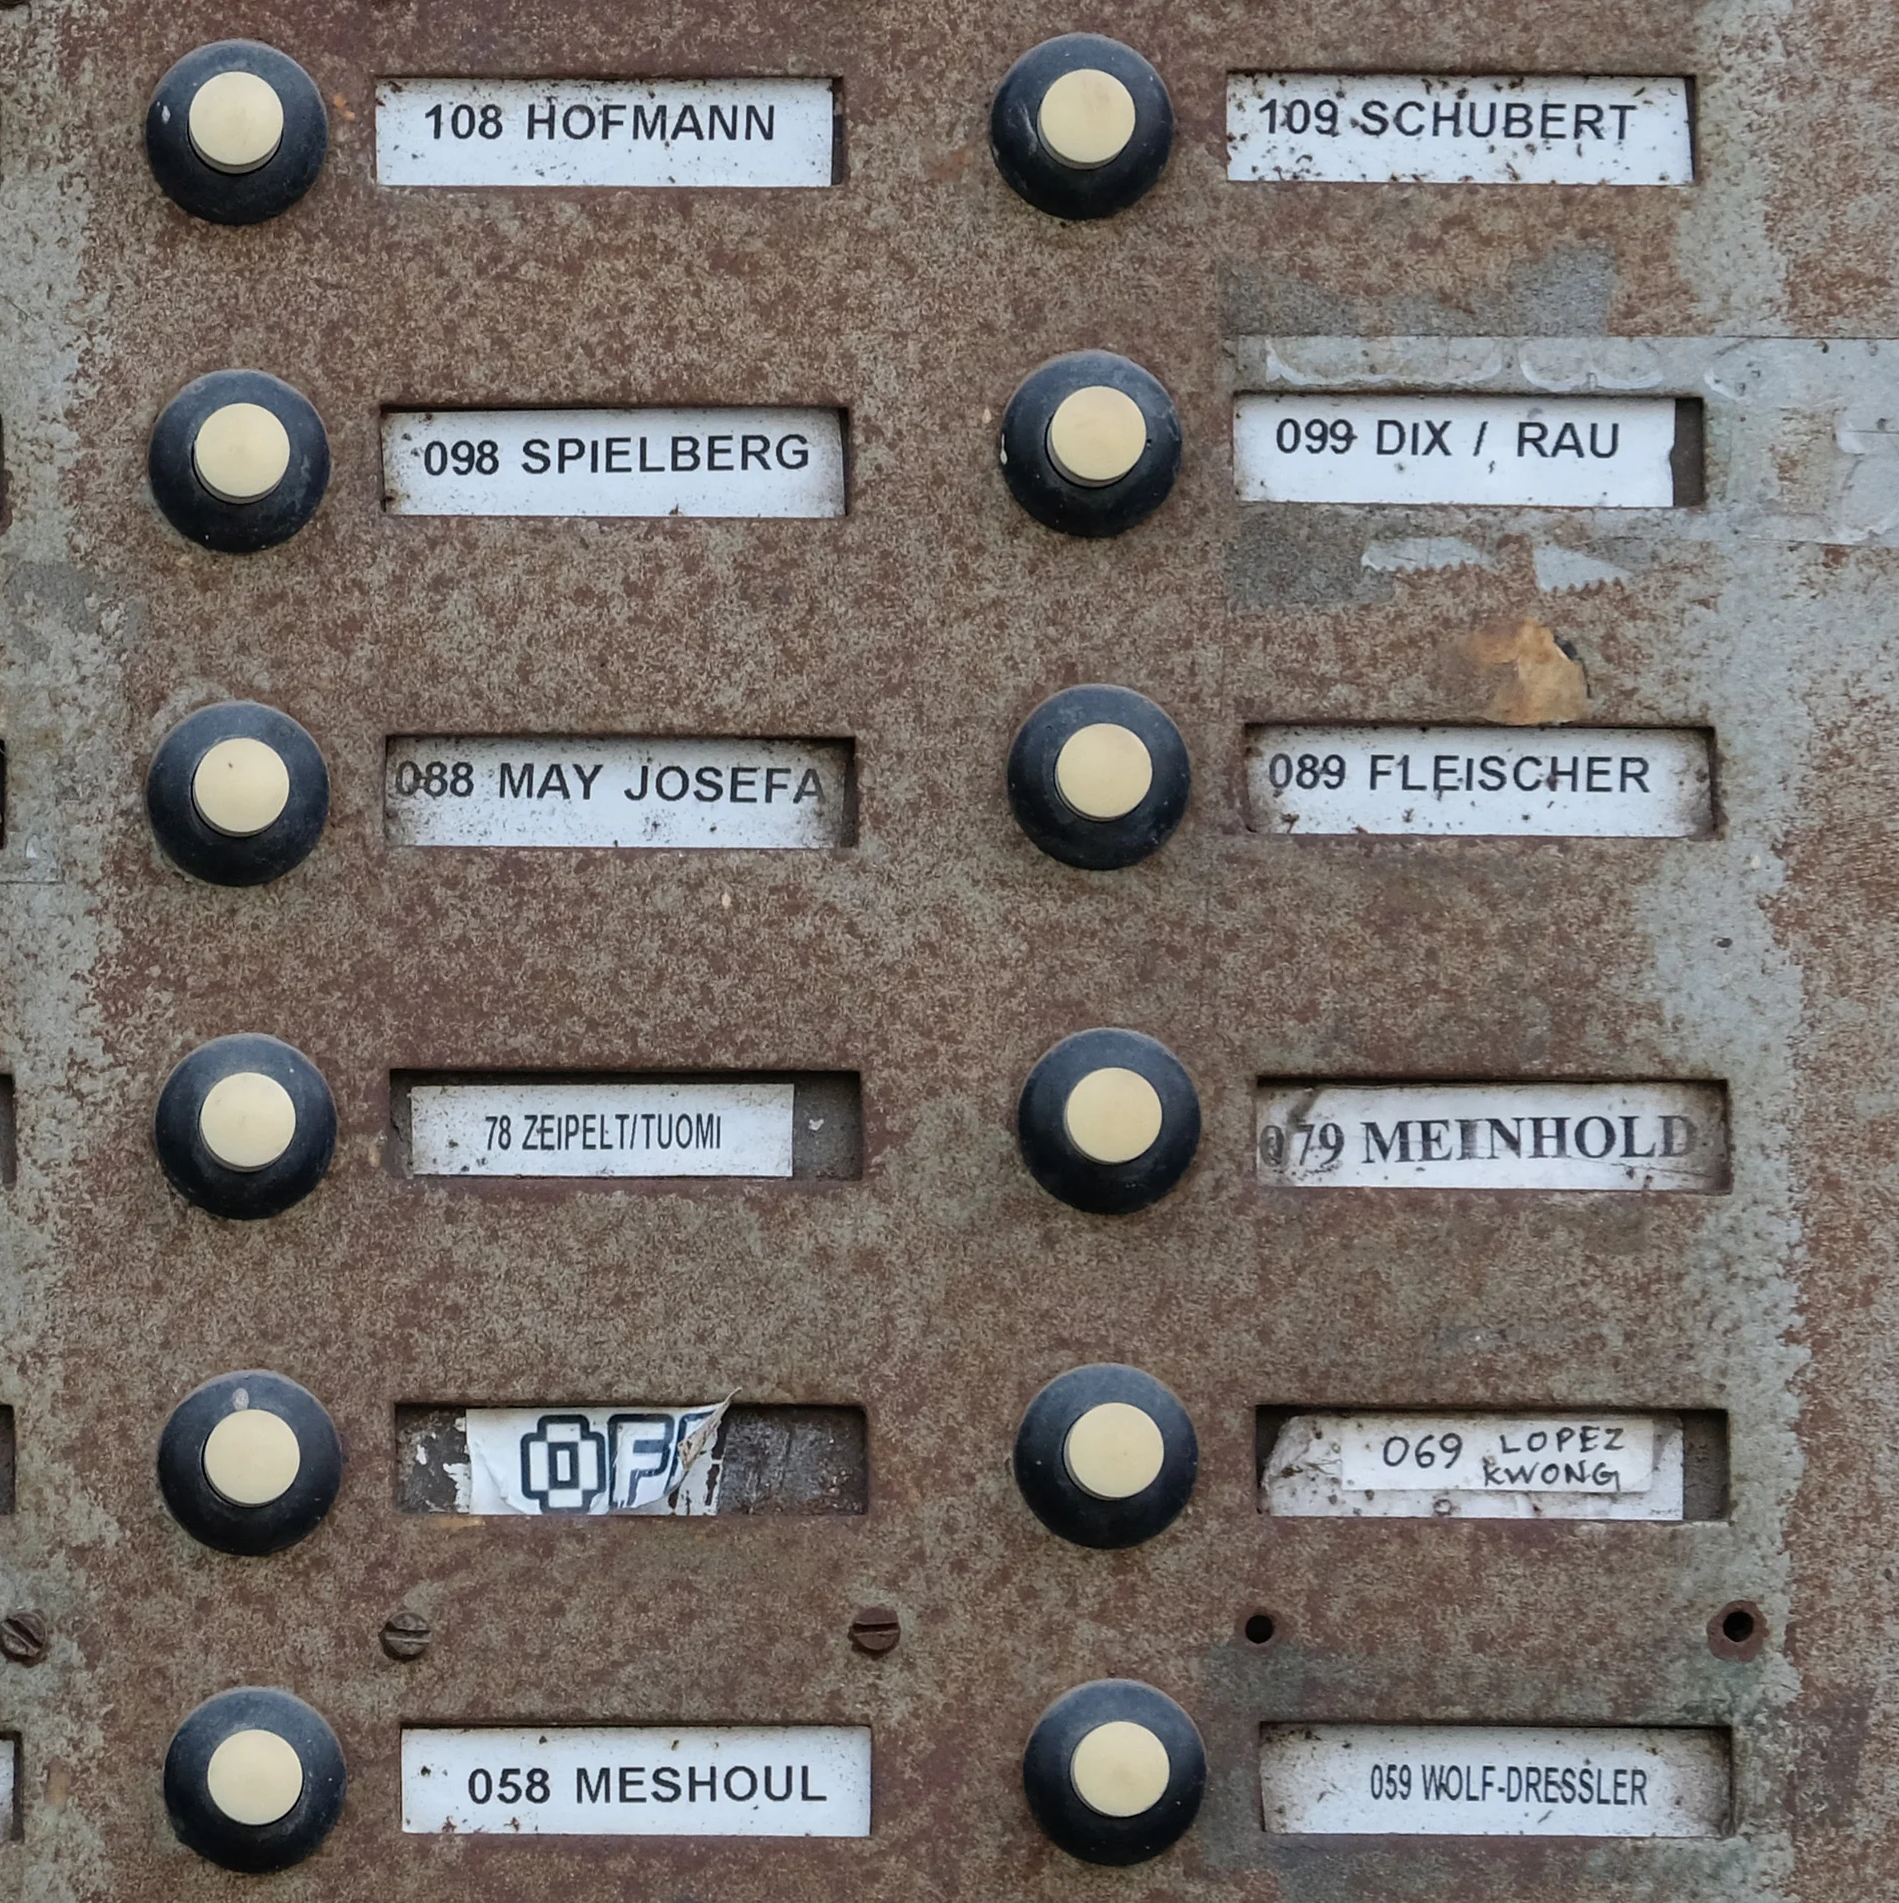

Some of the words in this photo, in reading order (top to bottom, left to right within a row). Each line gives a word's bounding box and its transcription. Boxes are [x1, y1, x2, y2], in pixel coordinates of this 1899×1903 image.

[424, 103, 503, 140] 108
[527, 102, 775, 141] HOFMANN
[1258, 98, 1340, 138] 109
[1352, 100, 1638, 141] SCHUBERT
[424, 439, 500, 477] 098
[521, 433, 809, 475] SPIELBERG
[1276, 417, 1358, 455] 099
[1376, 419, 1452, 457] DIX
[1517, 421, 1620, 459] RAU
[387, 752, 475, 801] 088
[499, 762, 604, 800] MAY
[624, 764, 827, 804] JOSEFA
[1267, 752, 1346, 799] 089
[1369, 754, 1650, 796] FLEISCHER
[484, 1114, 512, 1151] 78
[521, 1112, 721, 1151] ZEIPELT/TUOMI
[1361, 1114, 1698, 1163] MEINHOLD
[1382, 1432, 1463, 1468] 069
[1499, 1425, 1626, 1454] LOPEZ
[1483, 1456, 1621, 1490] KWONG
[468, 1767, 551, 1805] 058
[576, 1765, 828, 1804] MESHOUL
[1370, 1763, 1412, 1801] 059
[1421, 1764, 1648, 1806] WOLF-DRESSLER
